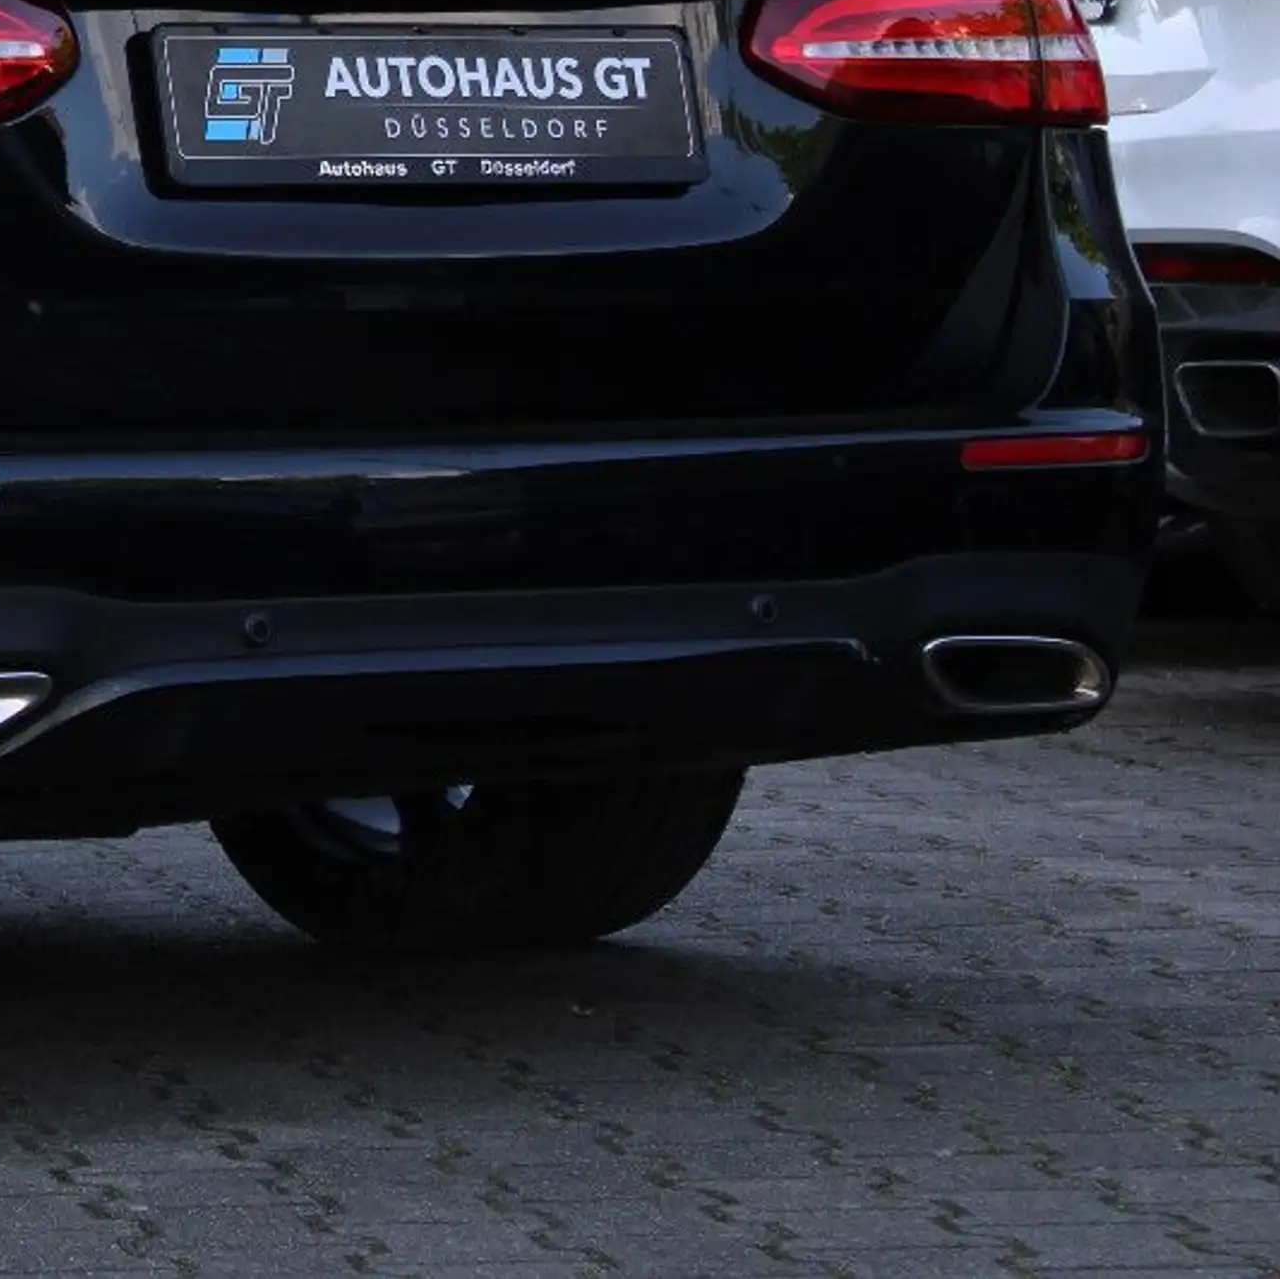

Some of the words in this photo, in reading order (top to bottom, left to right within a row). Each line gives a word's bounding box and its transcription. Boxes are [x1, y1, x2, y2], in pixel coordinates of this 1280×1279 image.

[325, 56, 583, 99] AUTOHAUS
[594, 57, 651, 99] GT
[384, 113, 608, 138] DÜSSELDORF
[319, 159, 408, 177] Autohaus
[431, 160, 458, 176] GT
[480, 159, 576, 177] Düsseldorf
